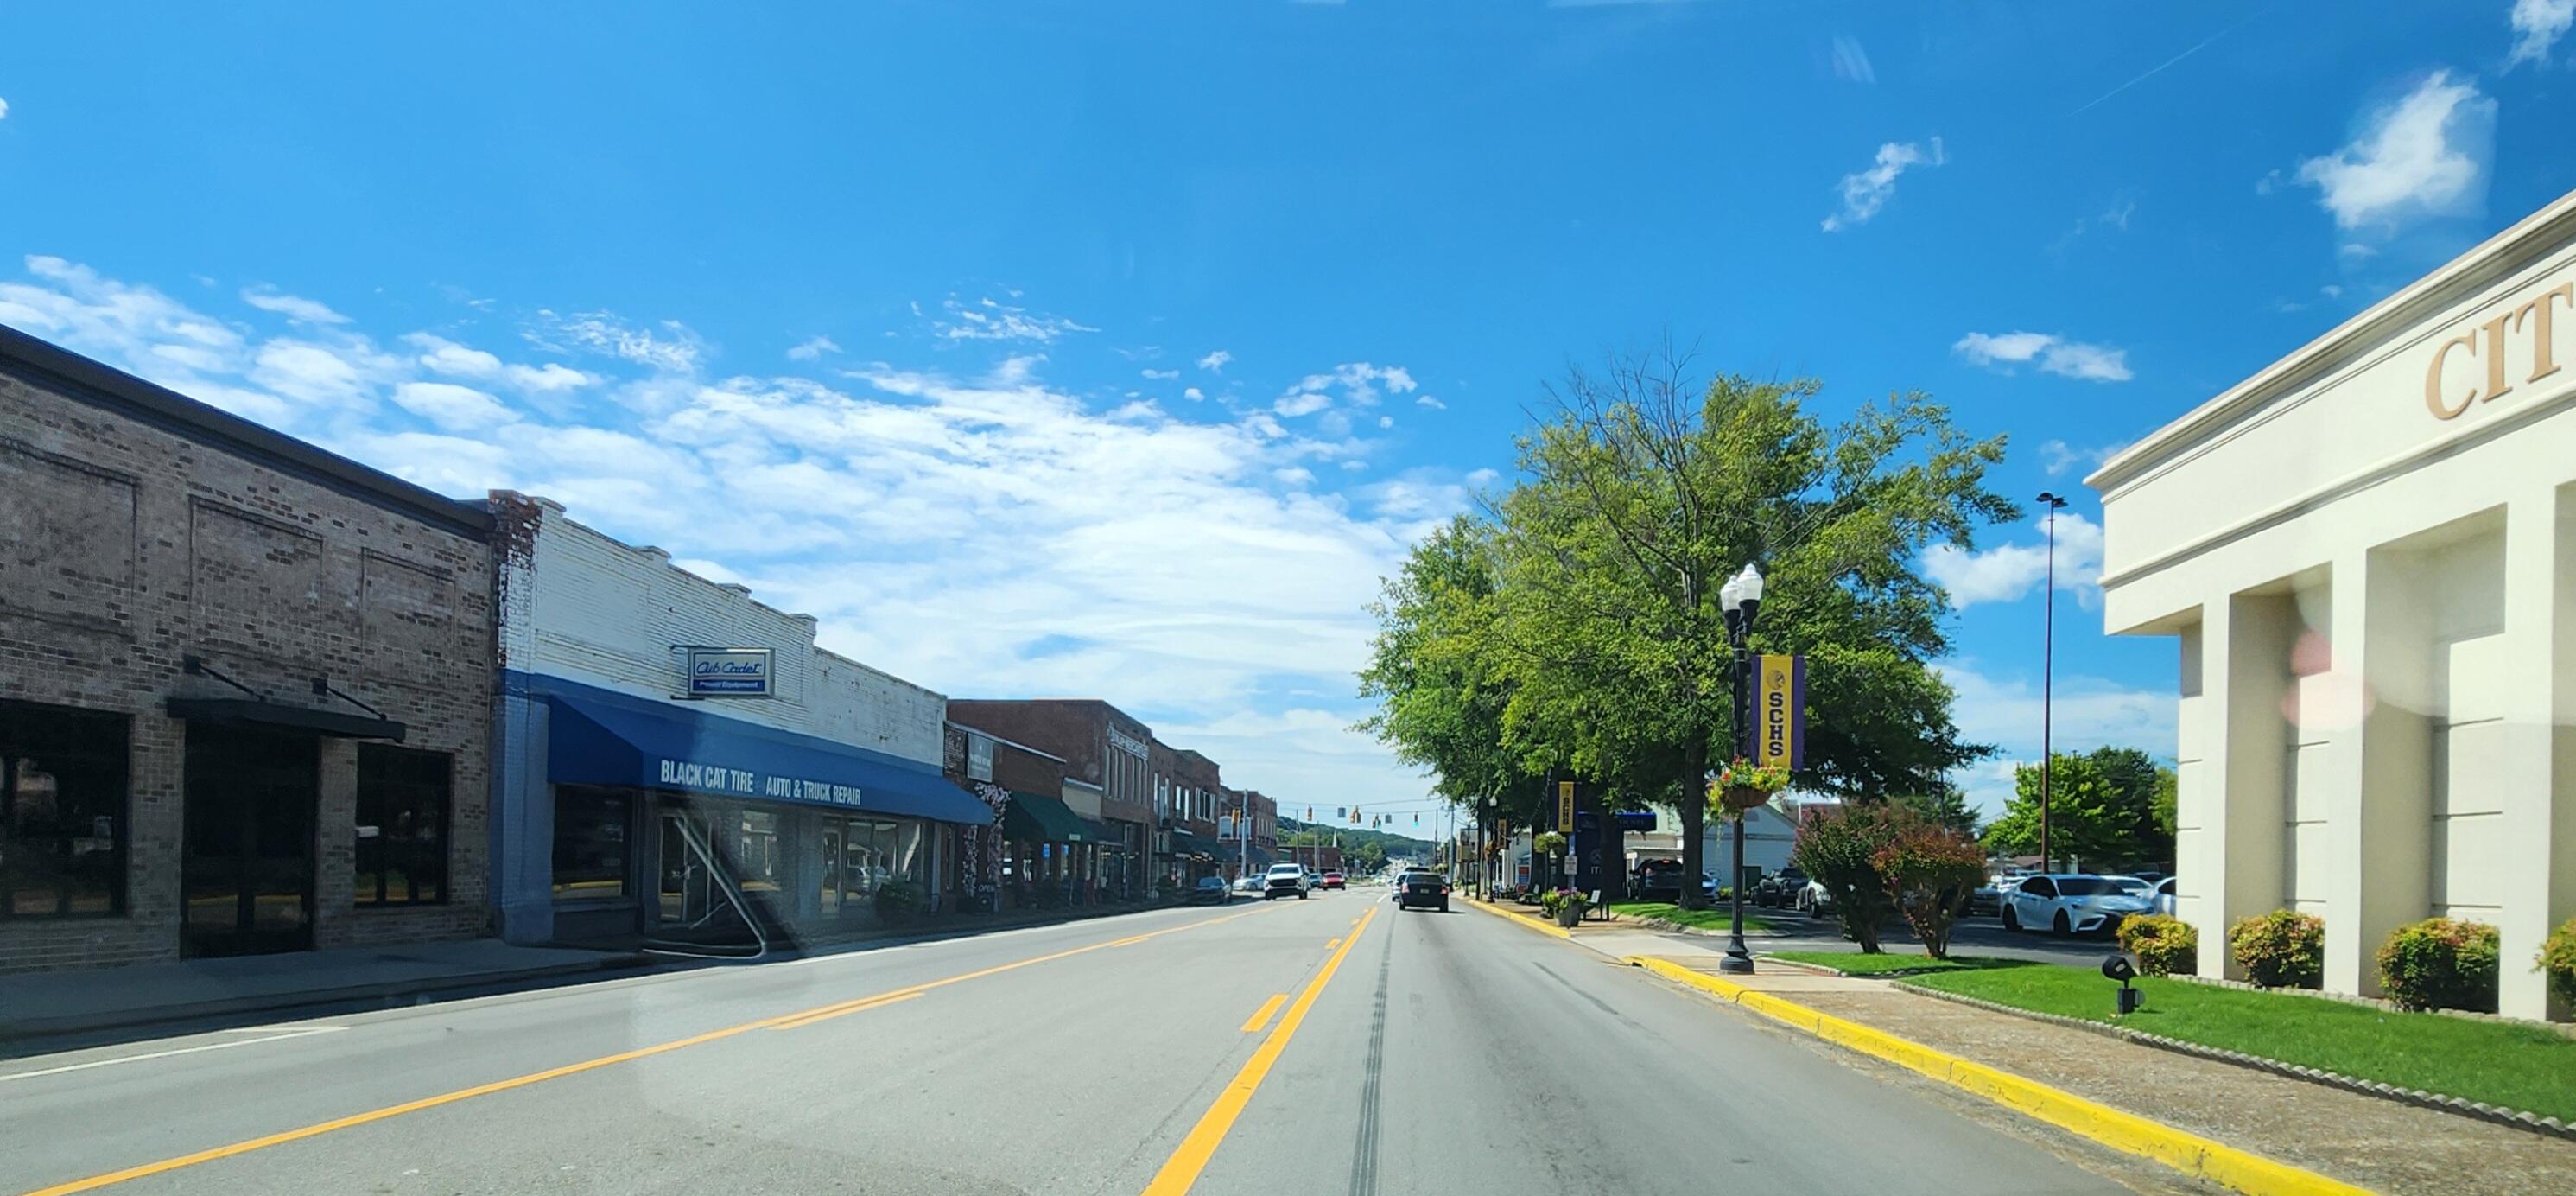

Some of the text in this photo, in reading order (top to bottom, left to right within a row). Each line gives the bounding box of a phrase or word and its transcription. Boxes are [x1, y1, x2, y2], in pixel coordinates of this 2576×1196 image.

[2425, 281, 2573, 421] CIT
[697, 661, 762, 673] Cub Cadet
[1768, 692, 1784, 756] SCHS
[661, 760, 860, 805] BLACK CAT TIRE AUTO & TRUCK REPAIR
